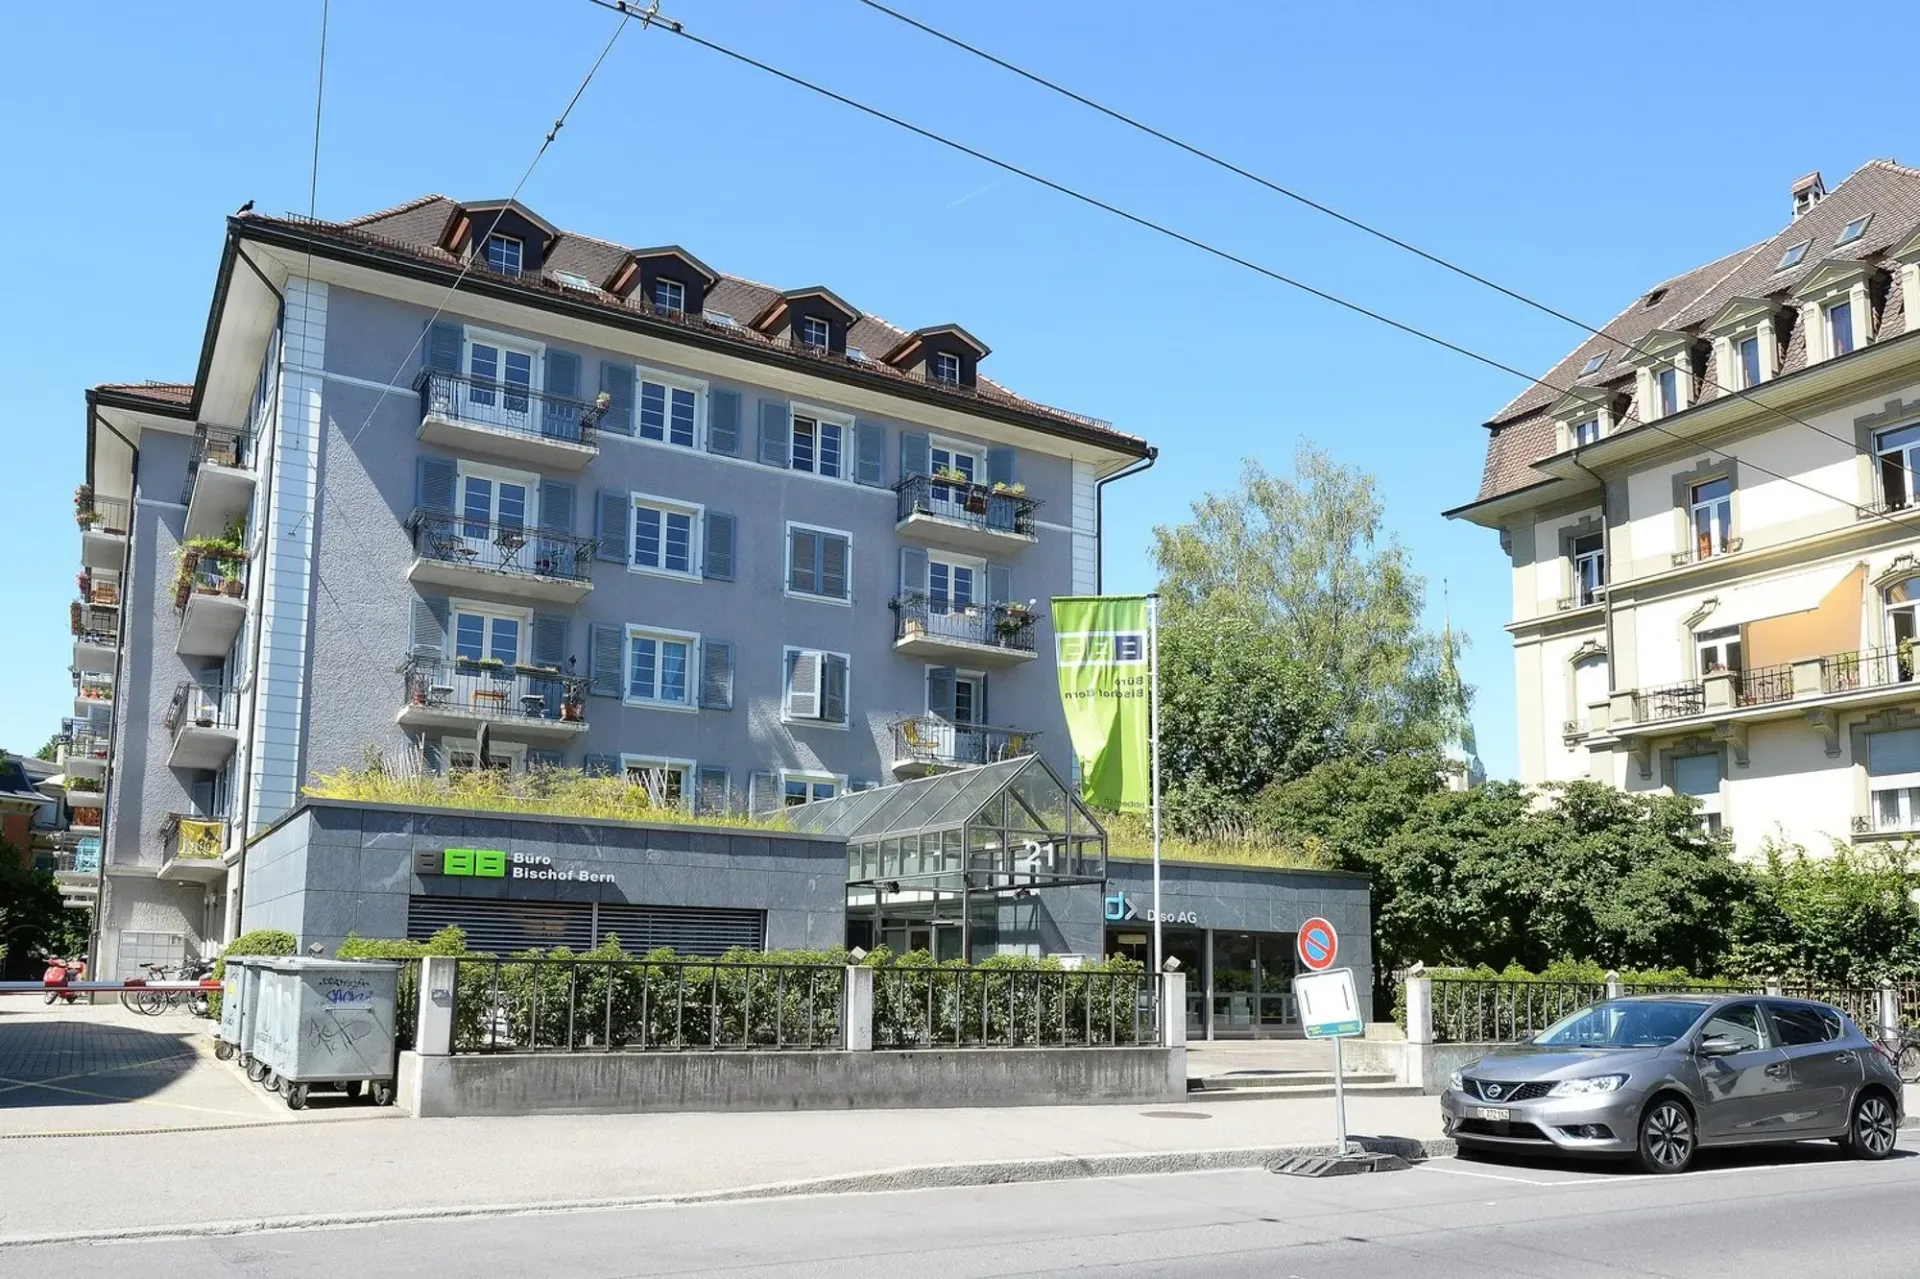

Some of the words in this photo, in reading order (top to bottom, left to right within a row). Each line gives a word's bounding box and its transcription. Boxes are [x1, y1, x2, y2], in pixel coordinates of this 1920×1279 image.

[513, 852, 551, 865] Büro
[1023, 840, 1053, 866] 21
[512, 867, 573, 881] Bischof
[579, 870, 615, 883] Bern
[1147, 909, 1175, 922] Dso
[1177, 911, 1197, 923] AG
